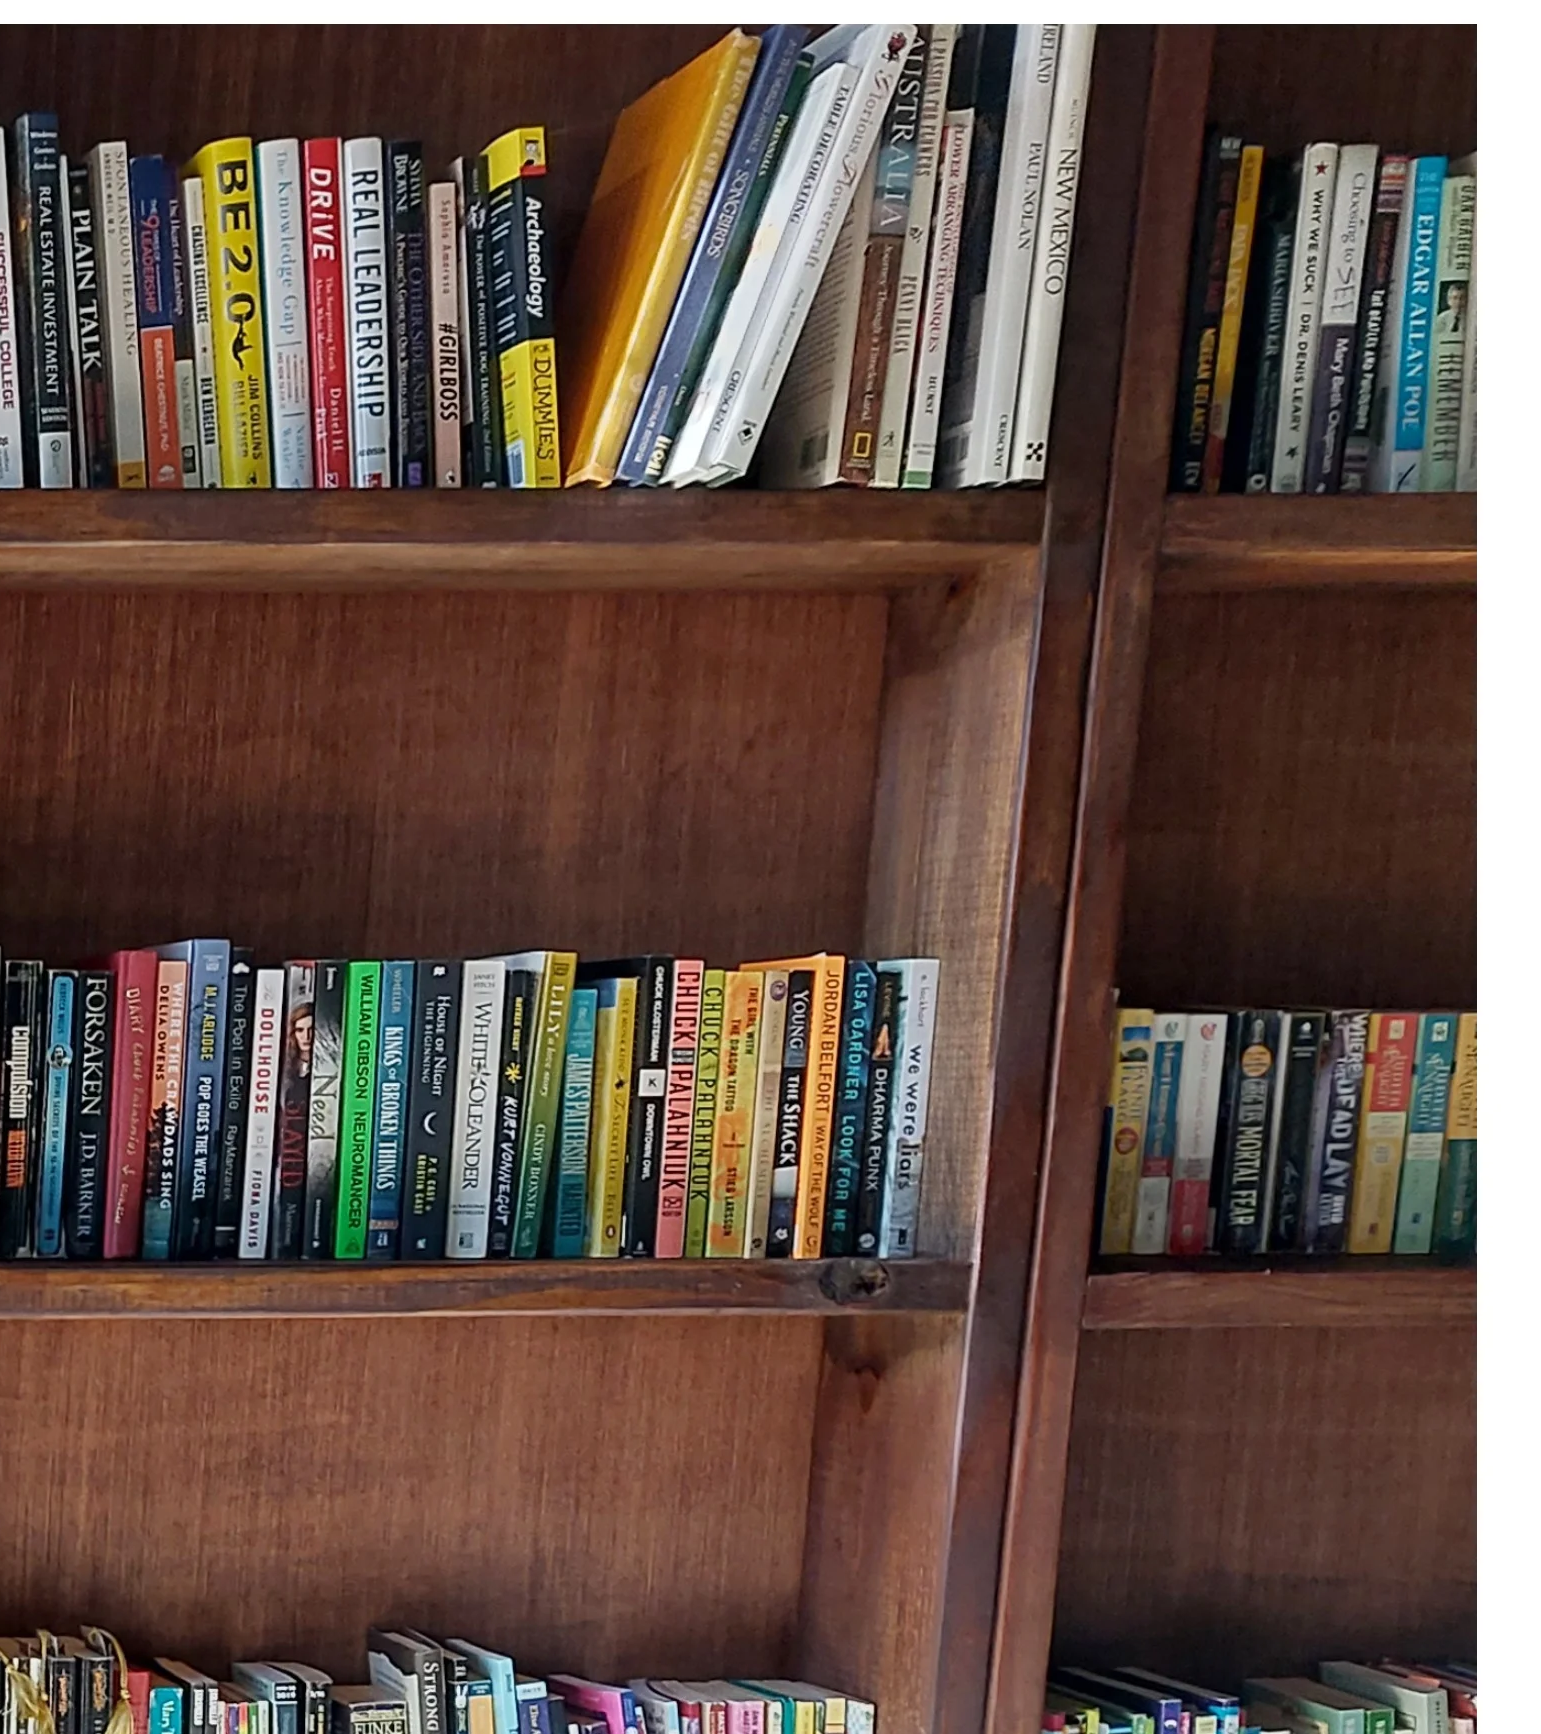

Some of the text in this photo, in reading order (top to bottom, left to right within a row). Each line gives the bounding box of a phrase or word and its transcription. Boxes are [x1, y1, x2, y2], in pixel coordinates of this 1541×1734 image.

[216, 159, 256, 323] BE 2.0
[524, 197, 546, 318] Archaeology
[1044, 148, 1078, 295] NEW MEXICO
[1304, 189, 1324, 293] WHY WE SUCK
[1412, 214, 1432, 293] EDGAR
[38, 187, 60, 395] REAL ESTATE INVESTMENT
[72, 209, 102, 372] PLAIN TALK
[352, 170, 384, 418] REAL LEADERSHIP
[1406, 303, 1426, 378] ALLAN
[439, 323, 456, 420] #GIRLBOSS
[534, 358, 554, 460] DUMMIES
[80, 977, 108, 1115] FORSAKEN
[255, 1008, 274, 1114] DOLLHOUSE
[355, 975, 374, 1099] WILLIAM GIBSON
[673, 972, 700, 1042] CHUCK
[815, 969, 840, 1113] JORDAN BELFORT
[6, 1026, 34, 1118] compulsion
[662, 1070, 693, 1190] PALAHNIUK
[866, 1068, 888, 1191] DHARMA PUNX
[348, 1111, 367, 1228] NEUROMANCER
[1230, 1126, 1261, 1225] MORTAL FEAR
